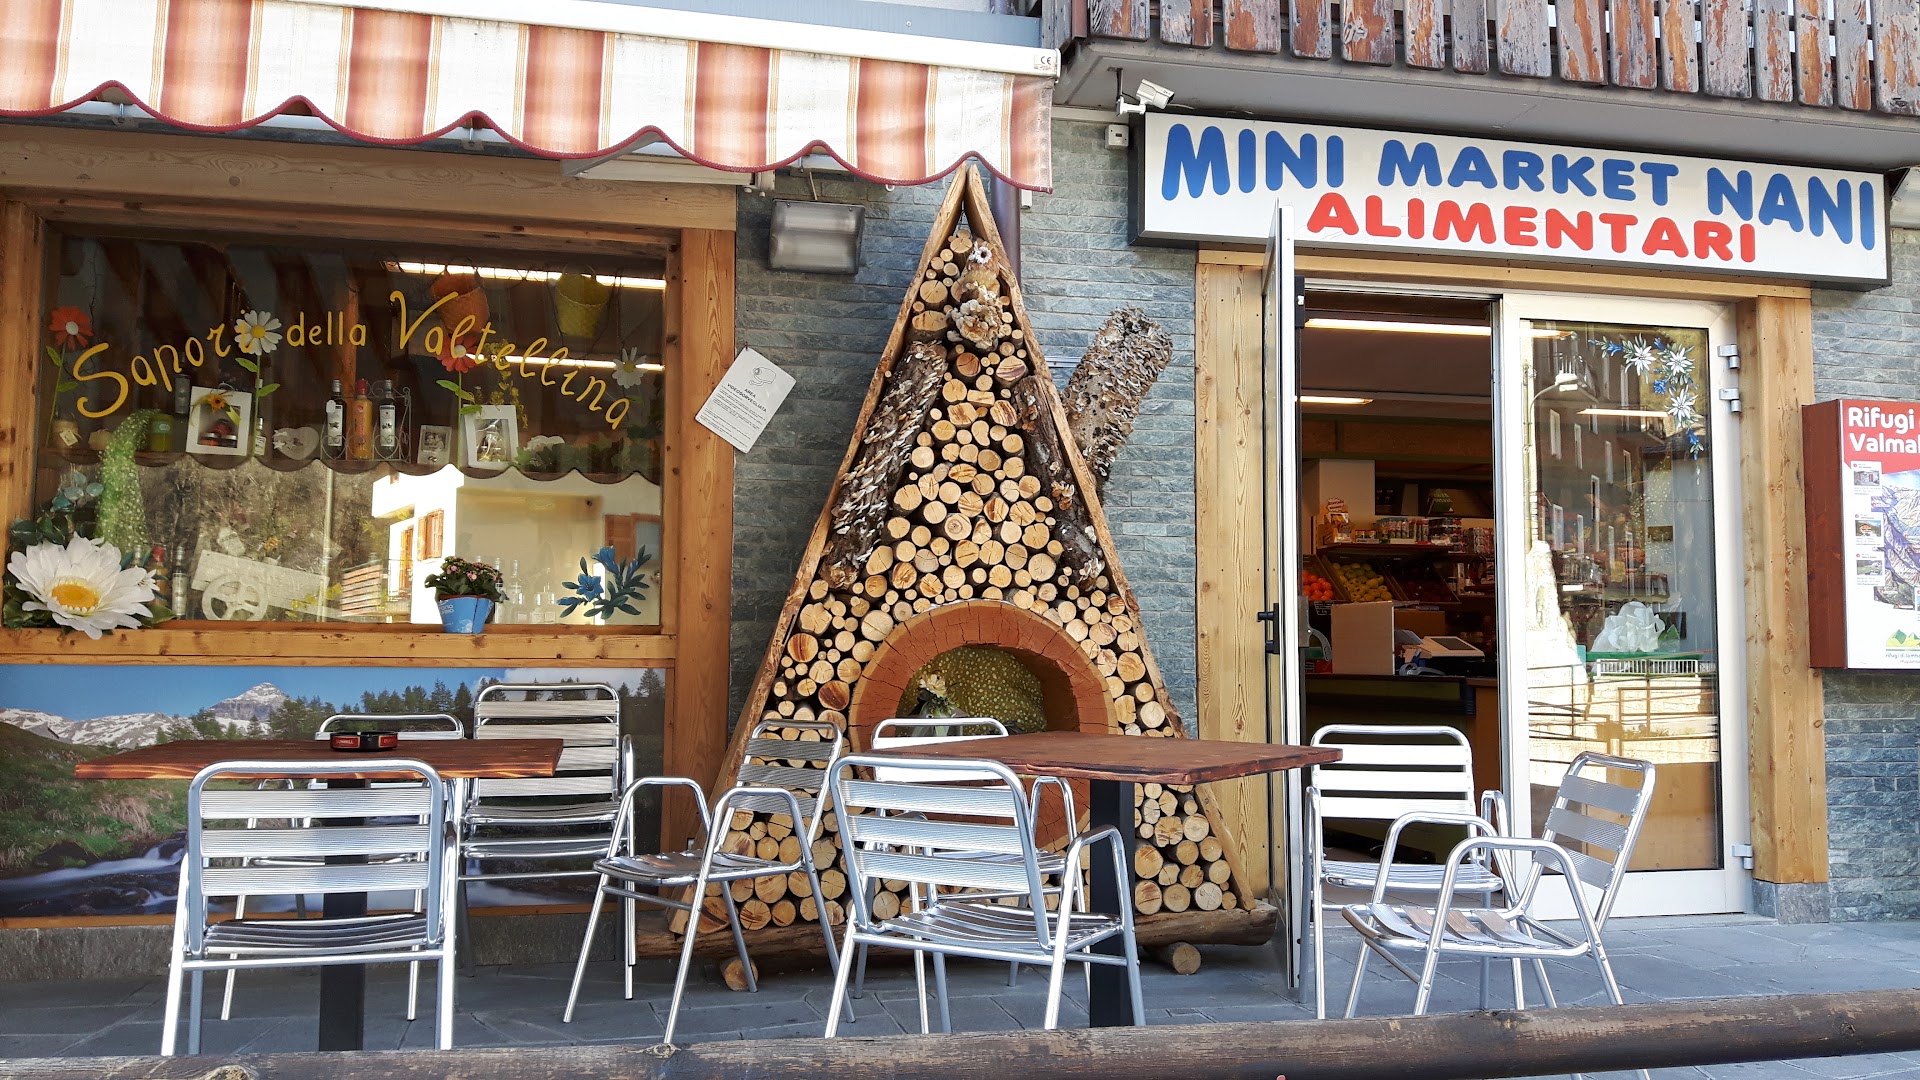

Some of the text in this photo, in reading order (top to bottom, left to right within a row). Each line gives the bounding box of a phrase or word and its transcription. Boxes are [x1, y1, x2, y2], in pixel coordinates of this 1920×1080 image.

[1161, 123, 1876, 251] MINI MARKET NANI
[1306, 192, 1756, 263] ALIMENTARI
[72, 290, 630, 431] Sapori della Valtellina
[744, 388, 756, 398] AREA
[1848, 406, 1915, 435] Rifugi
